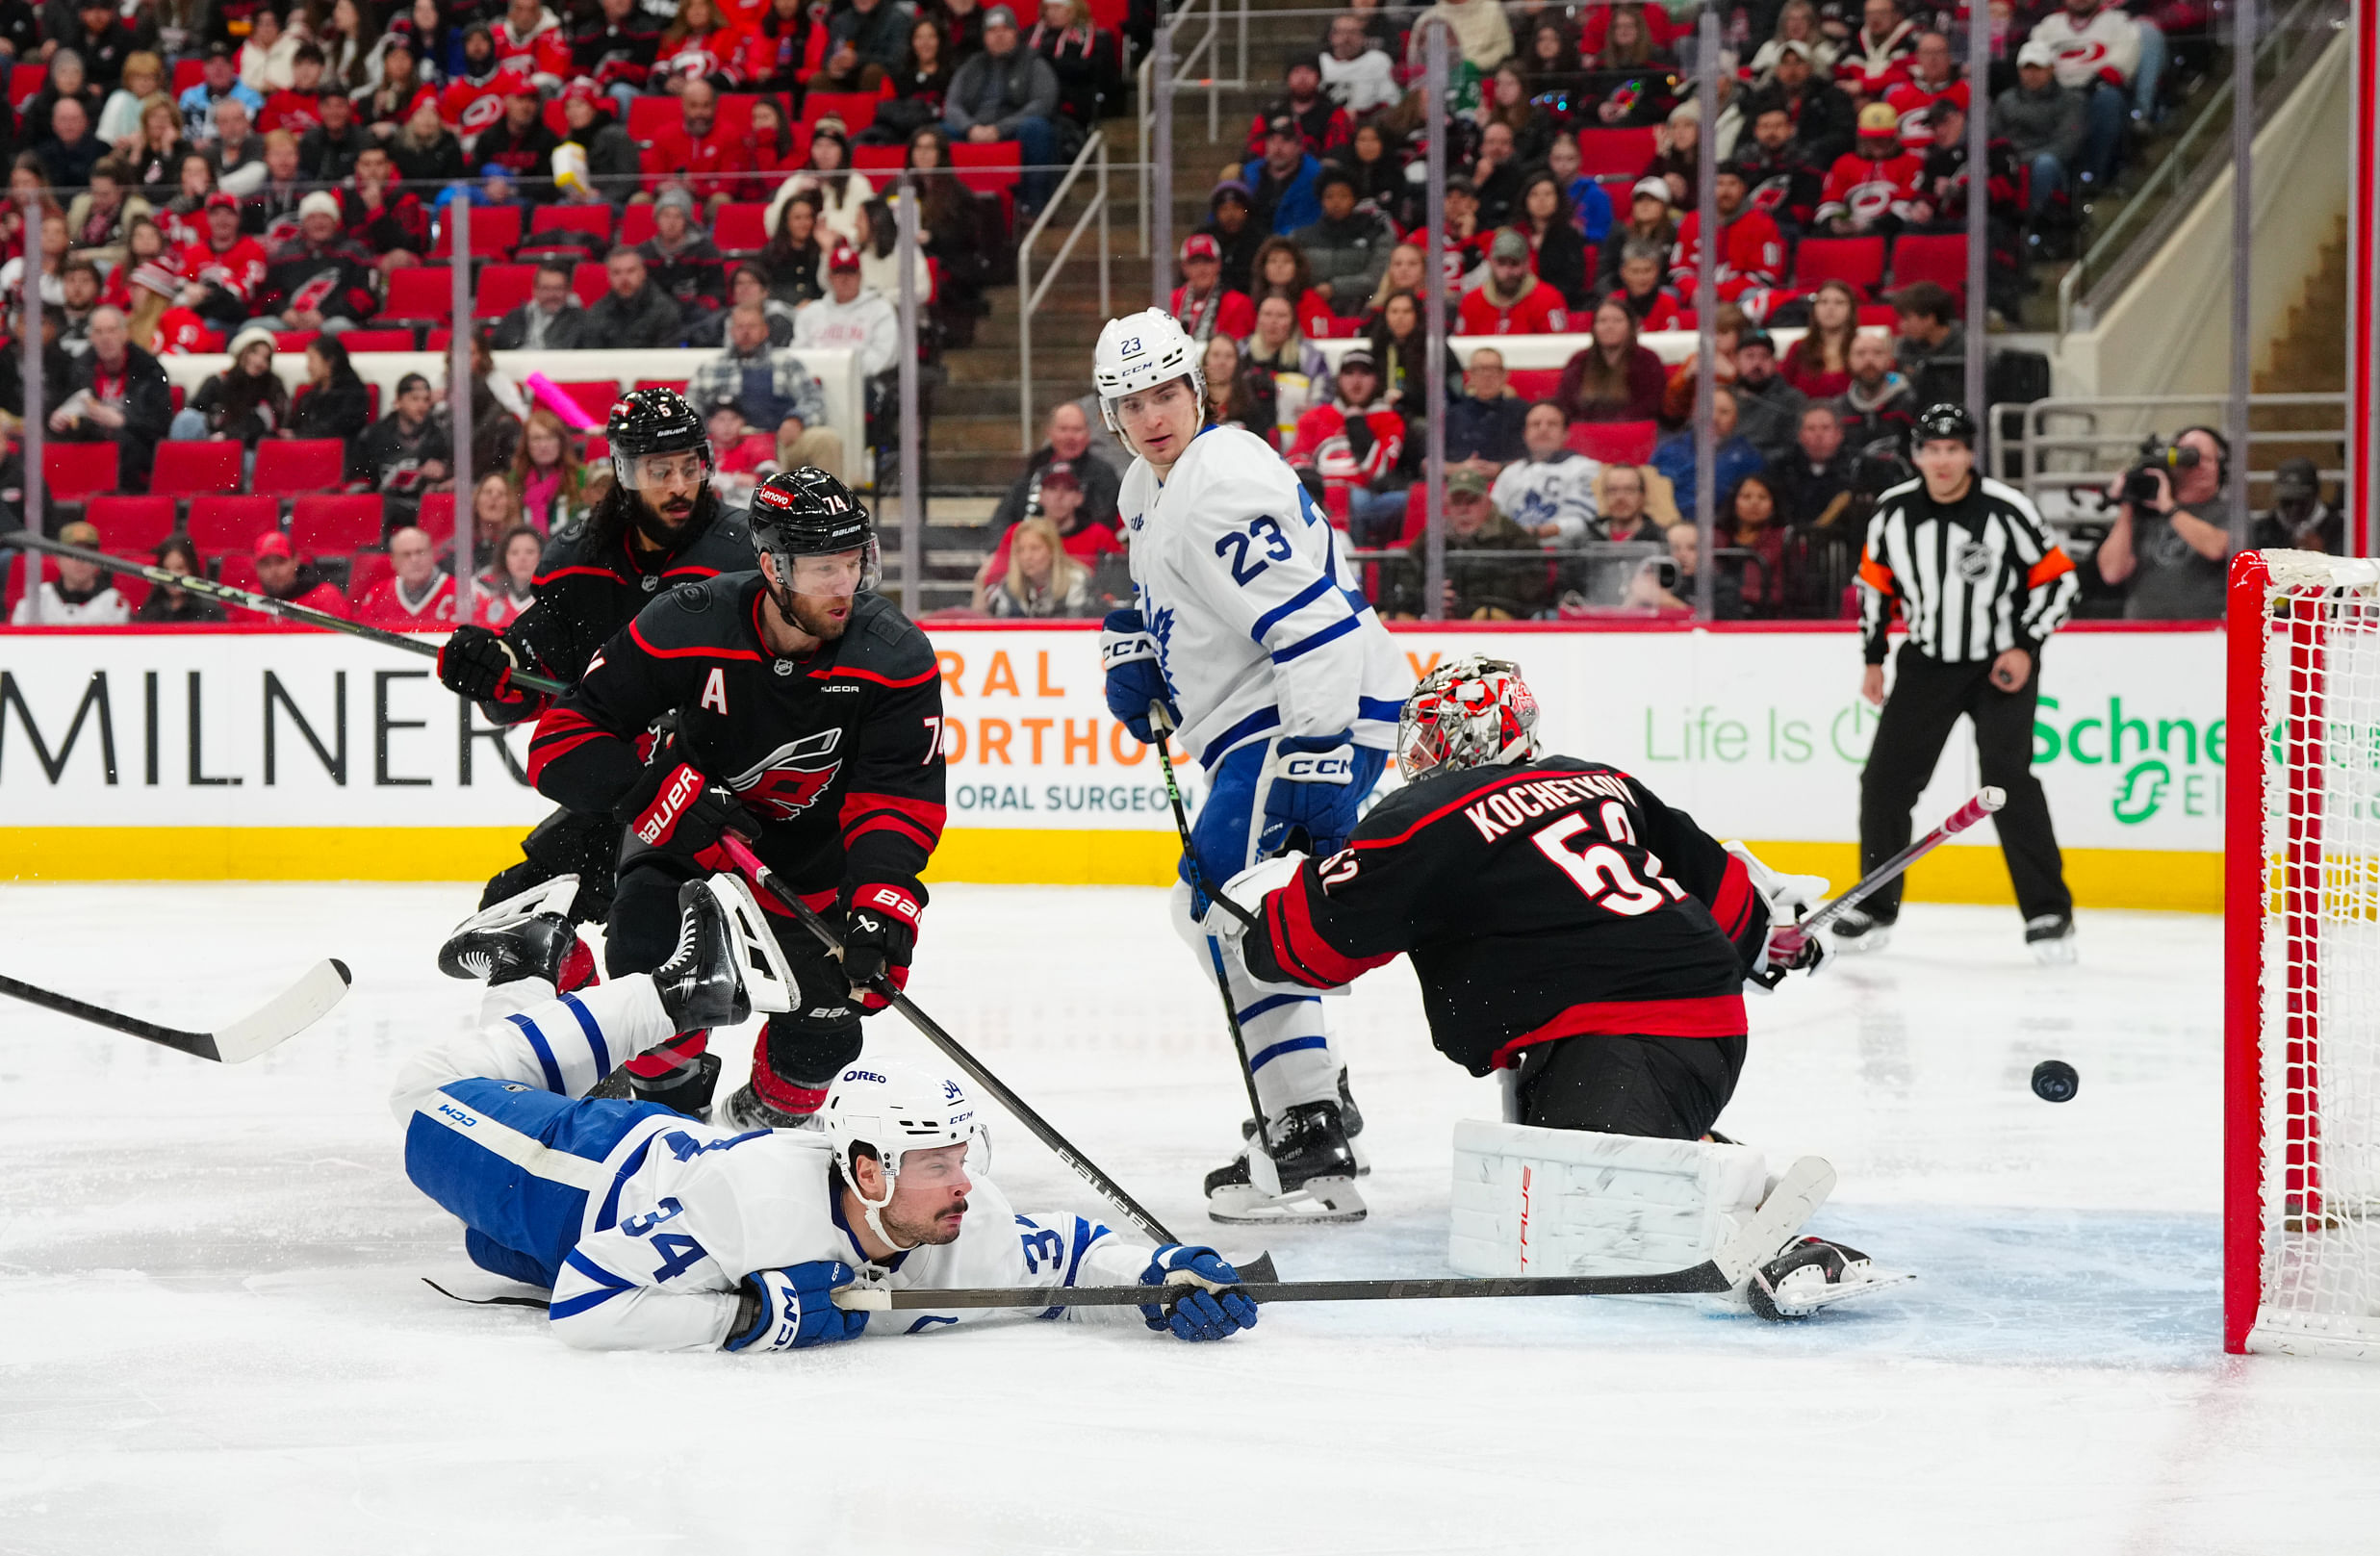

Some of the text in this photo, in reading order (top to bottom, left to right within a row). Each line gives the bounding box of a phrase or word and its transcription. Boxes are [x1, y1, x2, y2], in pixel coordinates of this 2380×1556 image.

[1120, 337, 1142, 355] 23
[1121, 362, 1153, 377] CCM
[657, 403, 672, 418] 5
[760, 488, 789, 505] Lenovo
[822, 495, 850, 516] 74
[1215, 514, 1292, 588] 23
[701, 667, 729, 716] A
[1646, 705, 1748, 763] Life
[1769, 706, 1814, 763] Is
[956, 785, 1193, 812] ORAL SURGEON
[1464, 774, 1638, 844] KOCHETKOV
[1318, 848, 1359, 896] 52
[1528, 809, 1690, 917] 52
[843, 1070, 887, 1084] OREO
[437, 1103, 478, 1128] CCM
[949, 1110, 974, 1125] CCM
[1520, 1164, 1532, 1274] TRUE
[620, 1196, 709, 1285] 34
